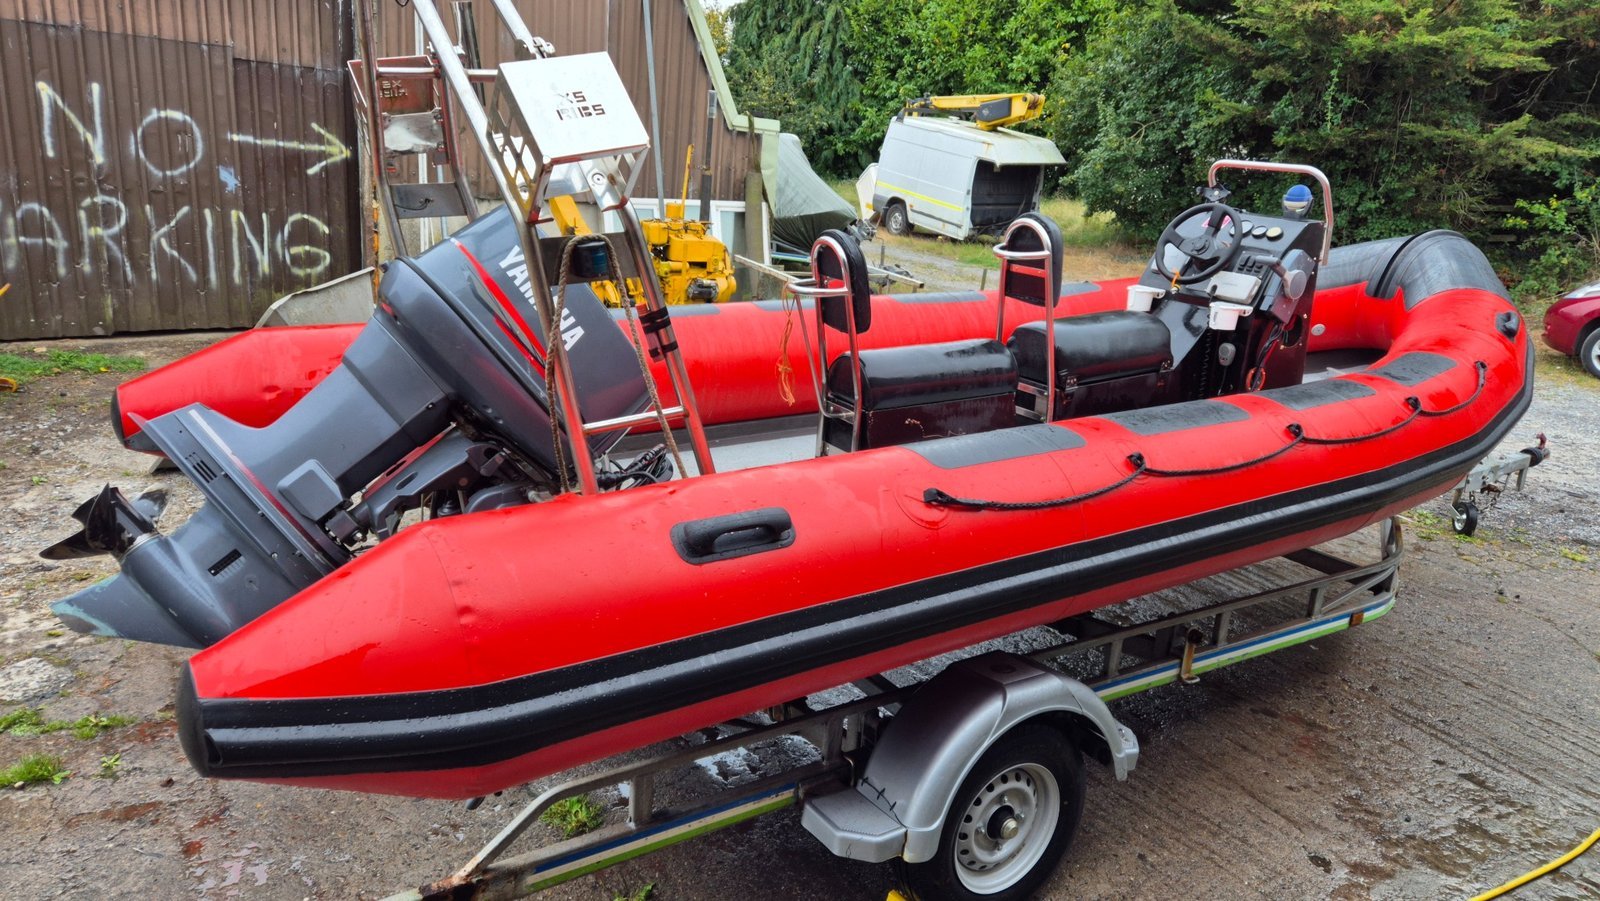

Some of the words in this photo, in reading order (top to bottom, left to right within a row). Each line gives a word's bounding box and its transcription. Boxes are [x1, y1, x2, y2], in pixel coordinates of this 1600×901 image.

[36, 81, 204, 177] NO
[554, 91, 587, 104] XS
[556, 104, 606, 121] RIBS
[0, 195, 331, 290] ARKING
[498, 245, 585, 351] YAHA
